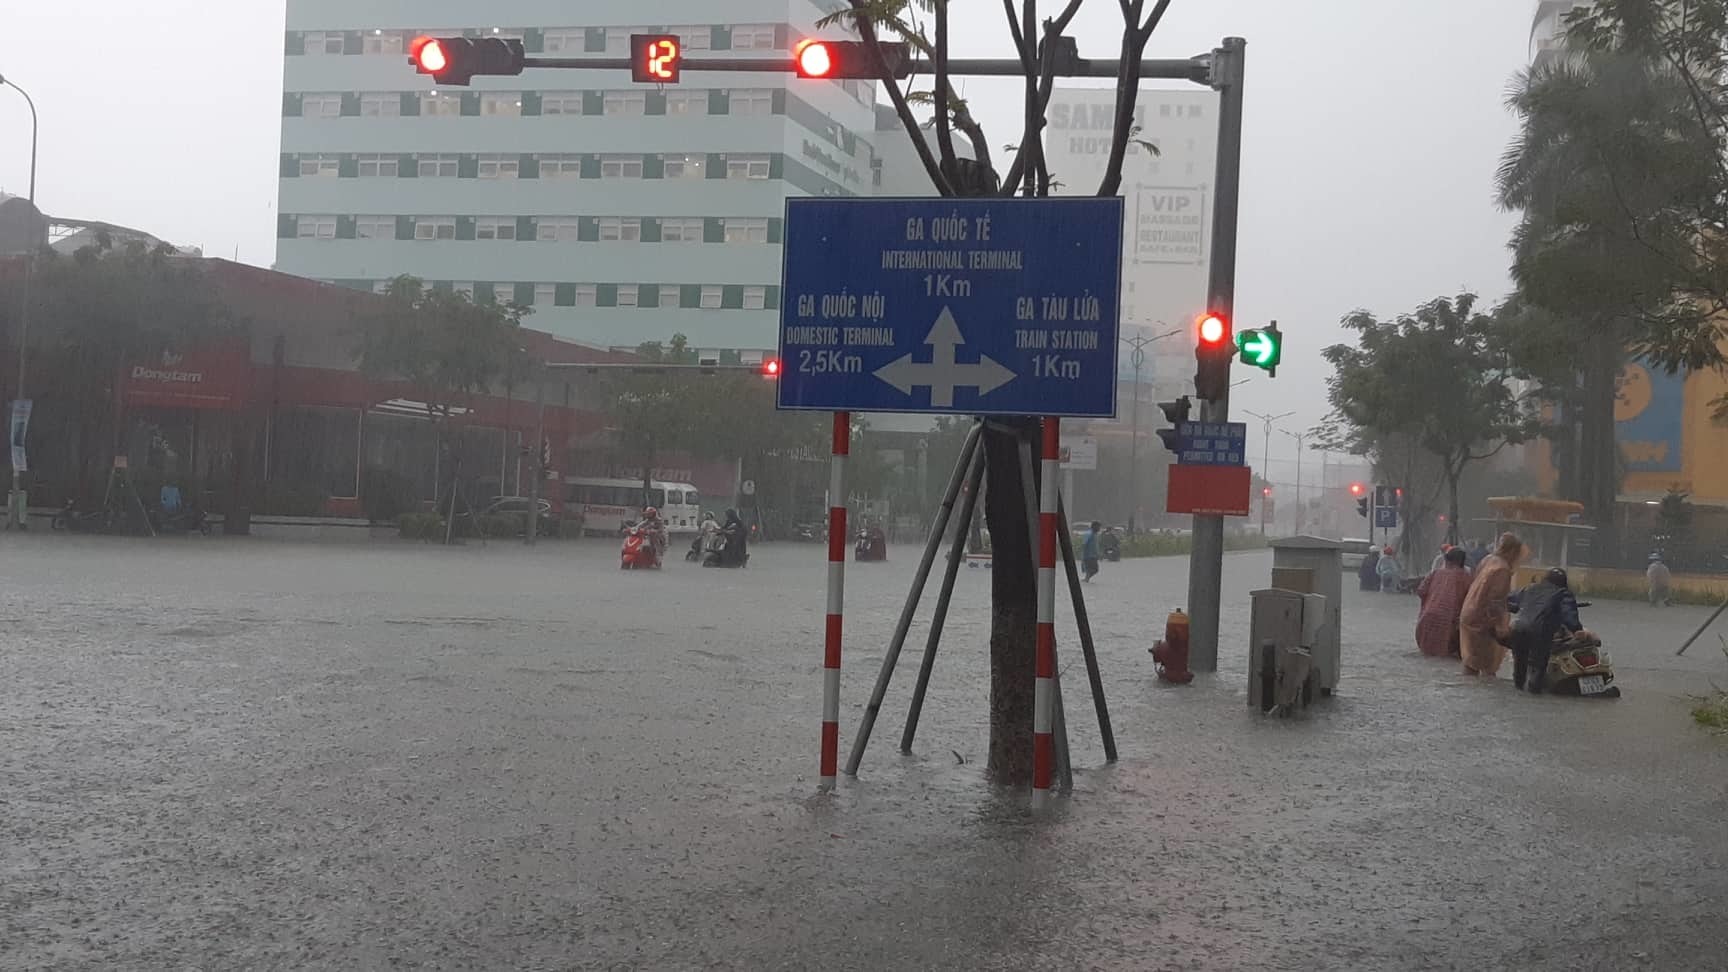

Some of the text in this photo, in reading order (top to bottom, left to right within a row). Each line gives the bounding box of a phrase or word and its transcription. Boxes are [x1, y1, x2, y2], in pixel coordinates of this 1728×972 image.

[649, 40, 675, 77] 12
[1152, 195, 1191, 212] VIP
[907, 208, 991, 242] GA QUỐC TẾ
[882, 250, 1023, 270] INTERNATIONAL TERMINAL
[924, 274, 971, 297] 1Km
[798, 286, 885, 322] GA QUỐC NỘI
[1016, 289, 1100, 320] GA TÀU LỬA
[786, 326, 895, 346] DOMESTIC TERMINAL
[1015, 329, 1098, 349] TRAIN STATION
[800, 350, 863, 377] 2,5Km
[1032, 354, 1080, 379] 1Km
[1380, 510, 1391, 522] P
